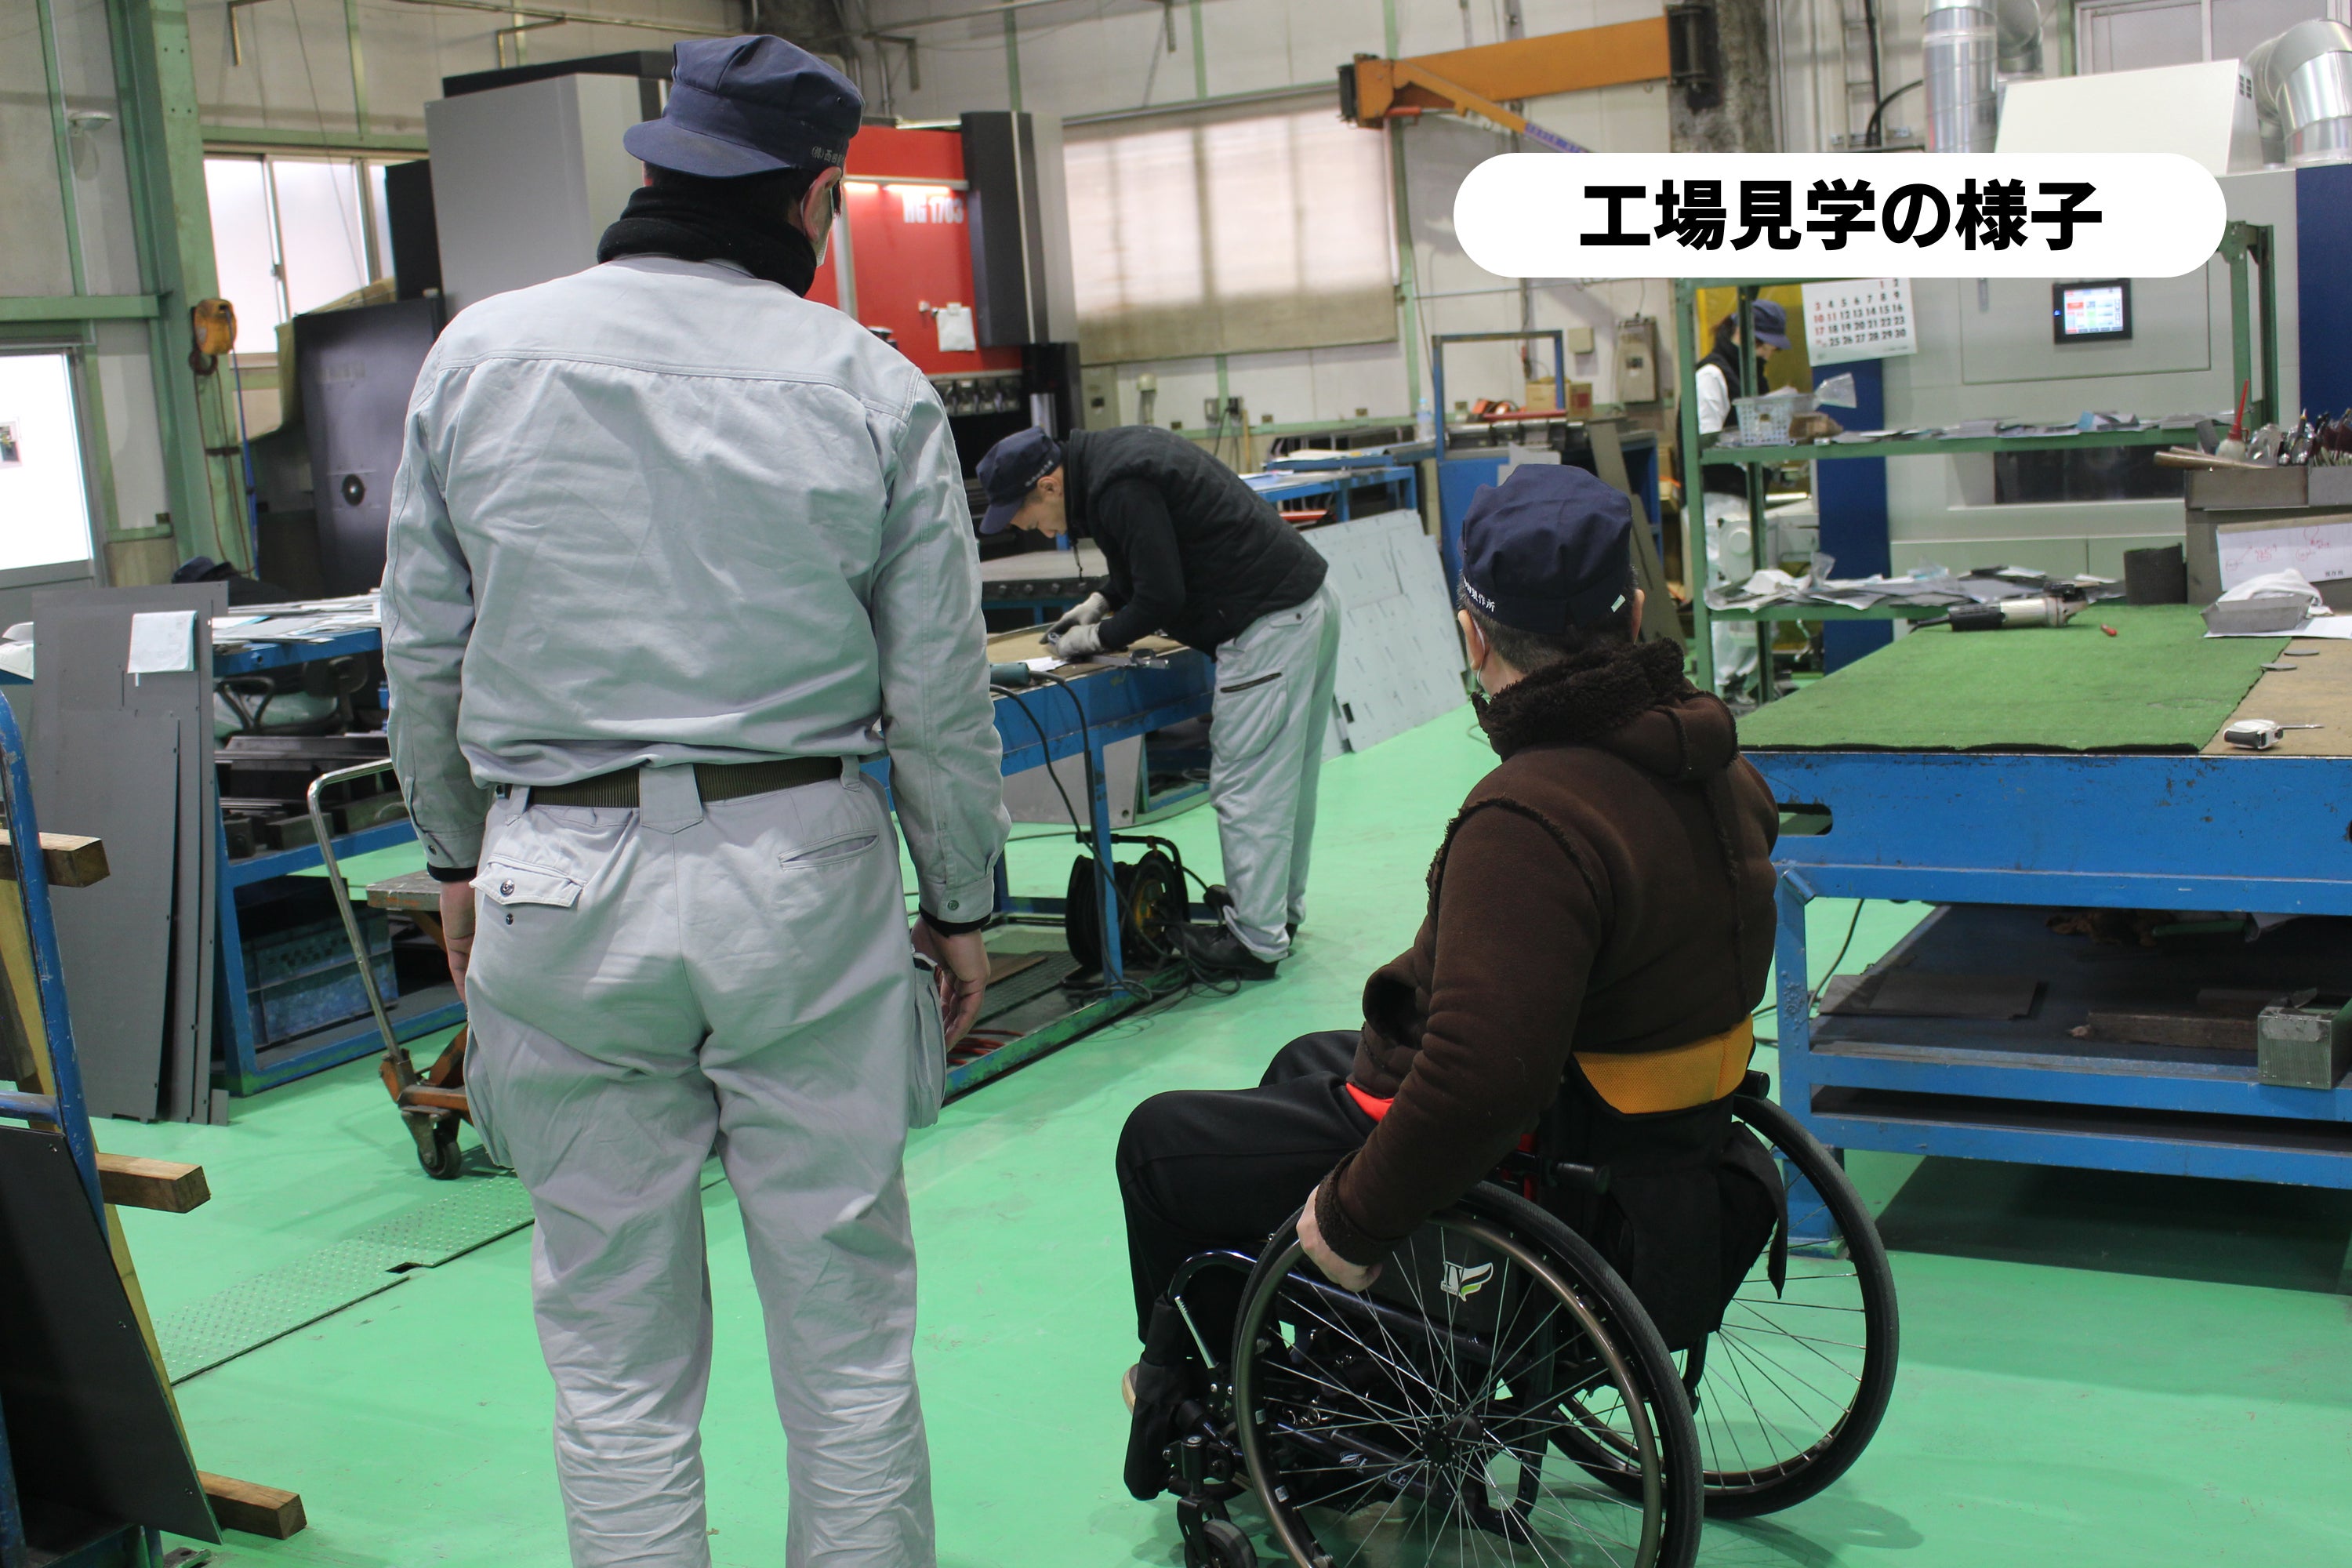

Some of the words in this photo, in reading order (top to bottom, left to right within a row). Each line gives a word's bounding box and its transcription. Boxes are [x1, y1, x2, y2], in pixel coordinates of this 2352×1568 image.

[1814, 314, 1824, 323] 10
[1828, 312, 1837, 321] 11
[1840, 310, 1850, 320] 12
[1853, 309, 1863, 318] 13
[1866, 307, 1876, 316] 14
[1879, 305, 1889, 314] 15
[1892, 303, 1903, 313] 16
[1815, 326, 1824, 336] 17
[1828, 325, 1838, 334] 18
[1841, 323, 1851, 332] 19
[1854, 321, 1864, 330] 20
[1867, 320, 1878, 328] 21
[1881, 318, 1891, 327] 22
[1894, 316, 1904, 325] 23
[1829, 337, 1839, 347] 25
[1842, 336, 1853, 345] 26
[1855, 334, 1865, 343] 27
[1868, 332, 1878, 342] 28
[1882, 330, 1892, 339] 29
[1895, 328, 1906, 338] 30
